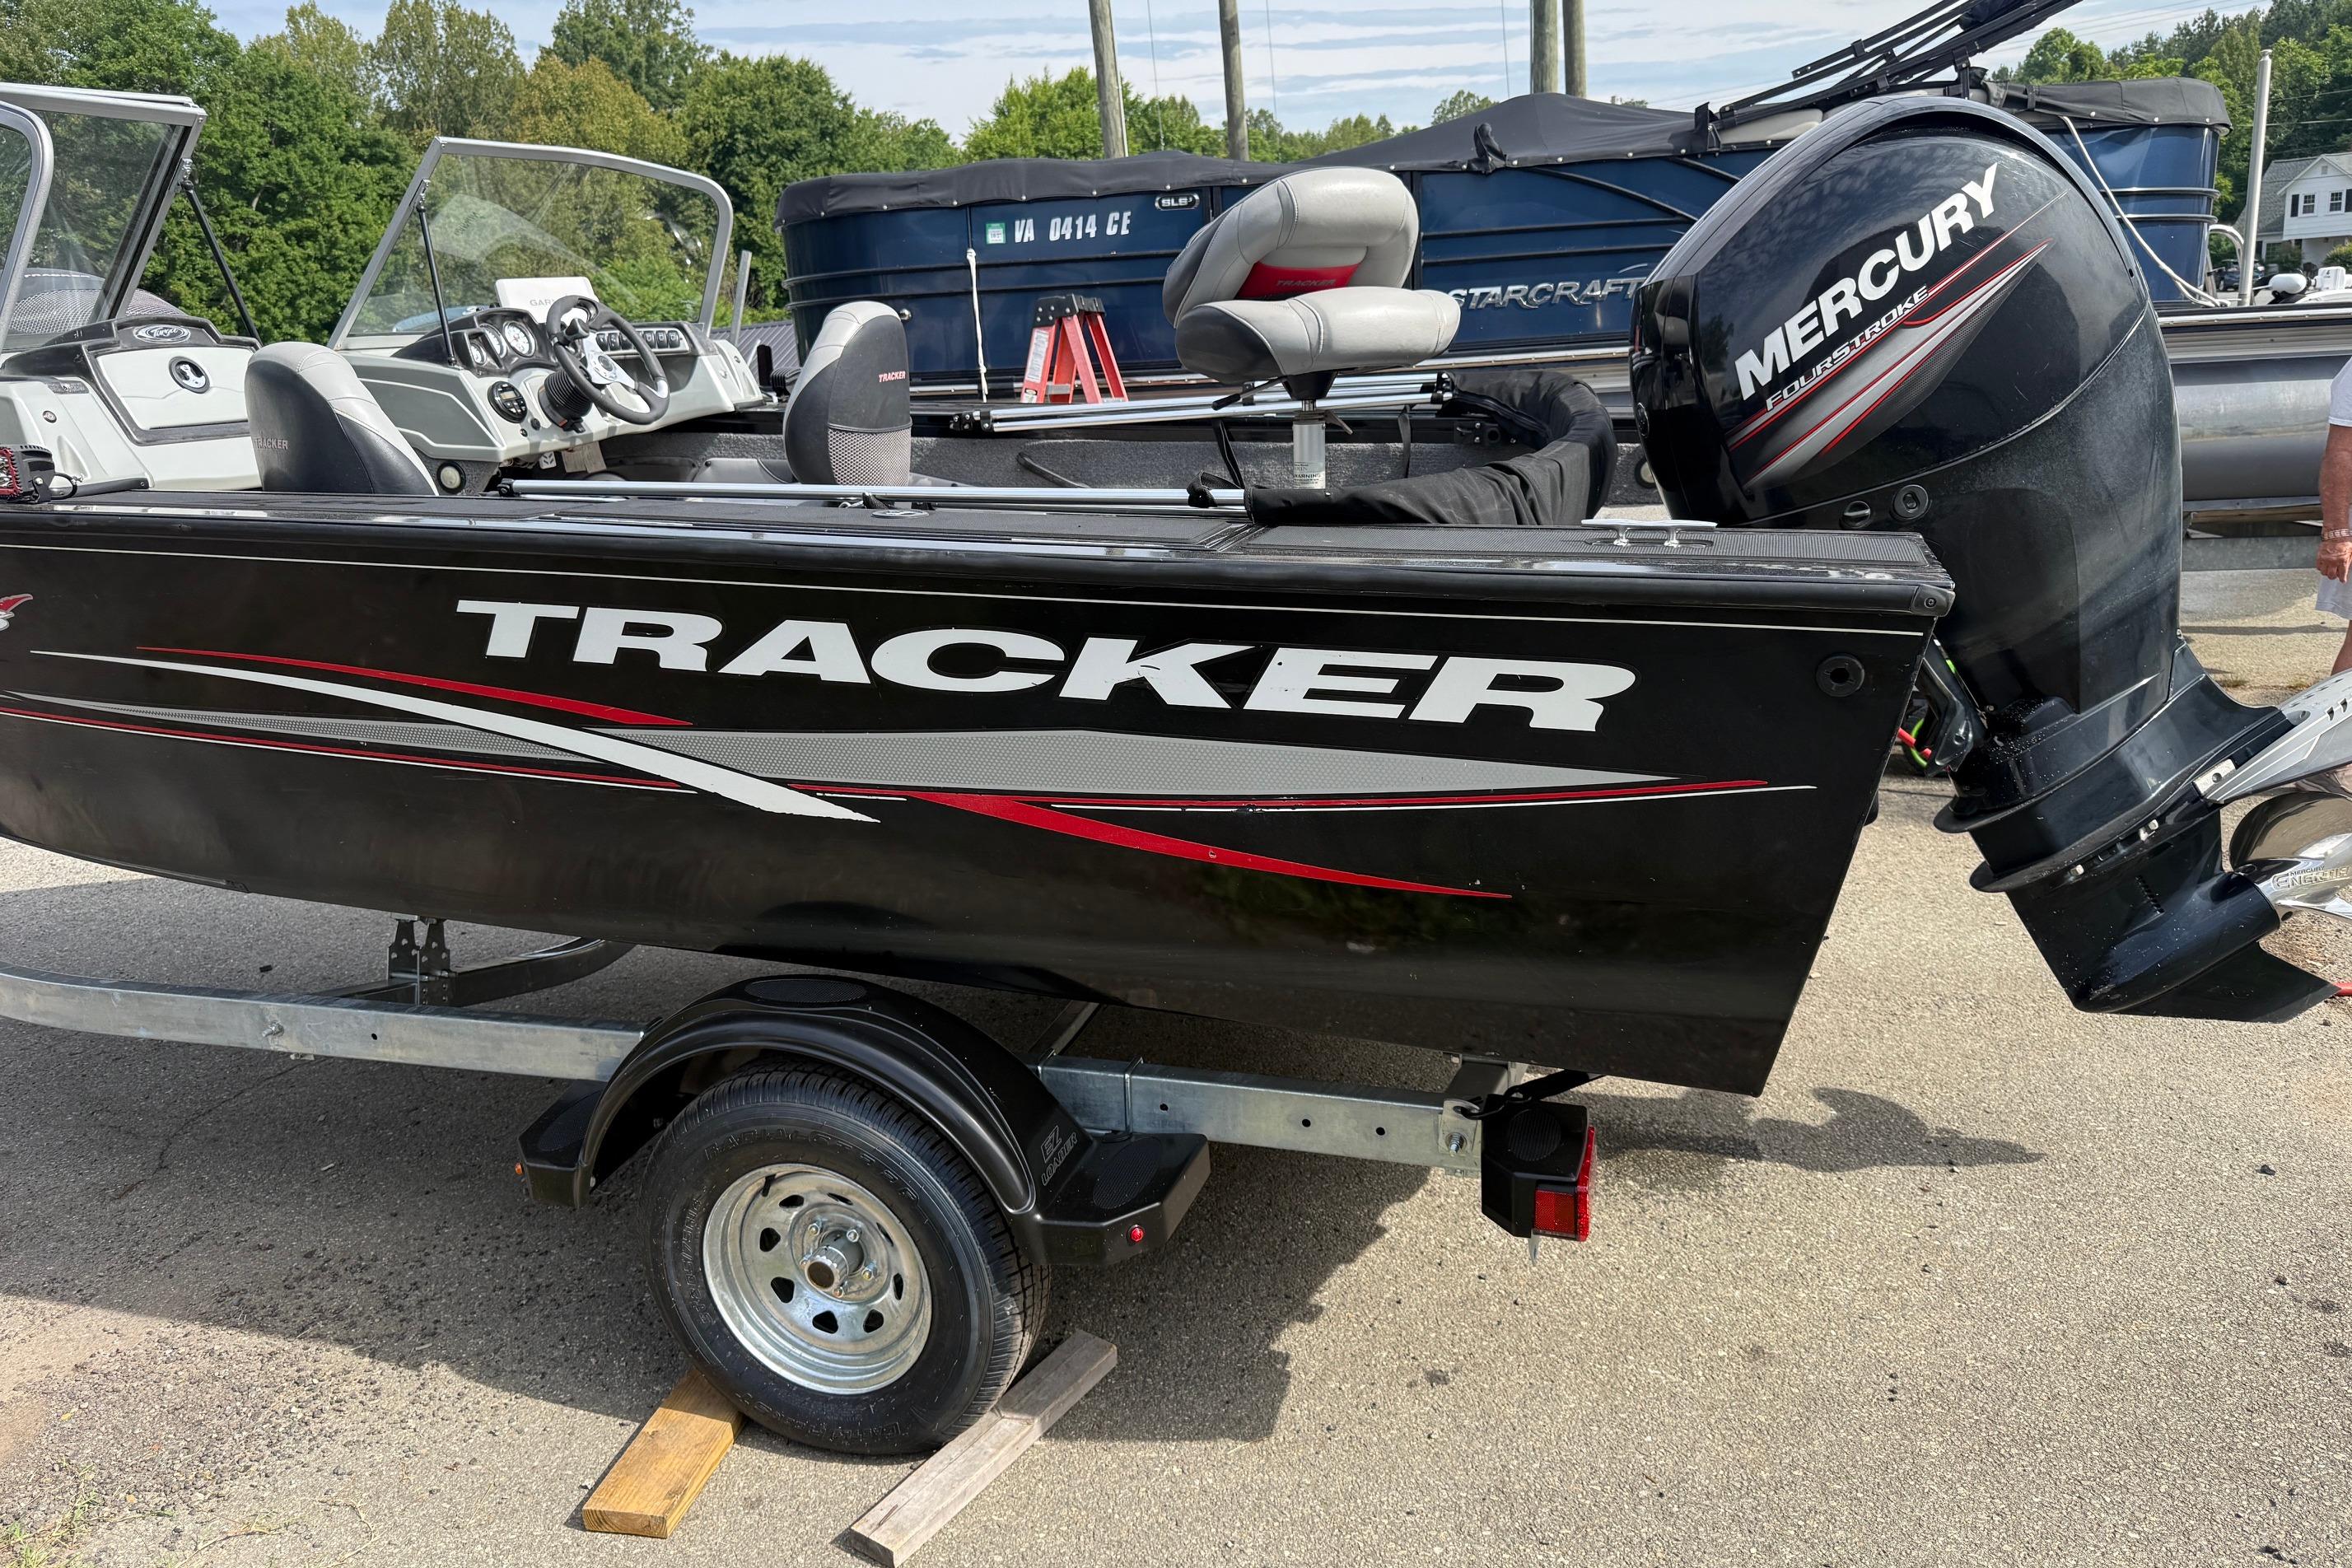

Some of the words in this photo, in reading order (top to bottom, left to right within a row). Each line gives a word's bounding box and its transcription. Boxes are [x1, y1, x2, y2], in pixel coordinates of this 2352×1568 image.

[1015, 218, 1035, 243] VA
[1048, 214, 1098, 241] 0414
[1105, 211, 1132, 236] CE
[1276, 278, 1337, 287] TRACKER
[1447, 276, 1648, 310] STARCRAFT
[1734, 162, 1998, 401] MERCURY
[1767, 285, 1929, 412] FOURSTROKE
[878, 371, 906, 383] TRACKER
[253, 436, 288, 450] TRACKER
[457, 600, 1636, 732] TRACKER
[1041, 1125, 1062, 1163] EZ
[1042, 1132, 1077, 1186] LOADER
